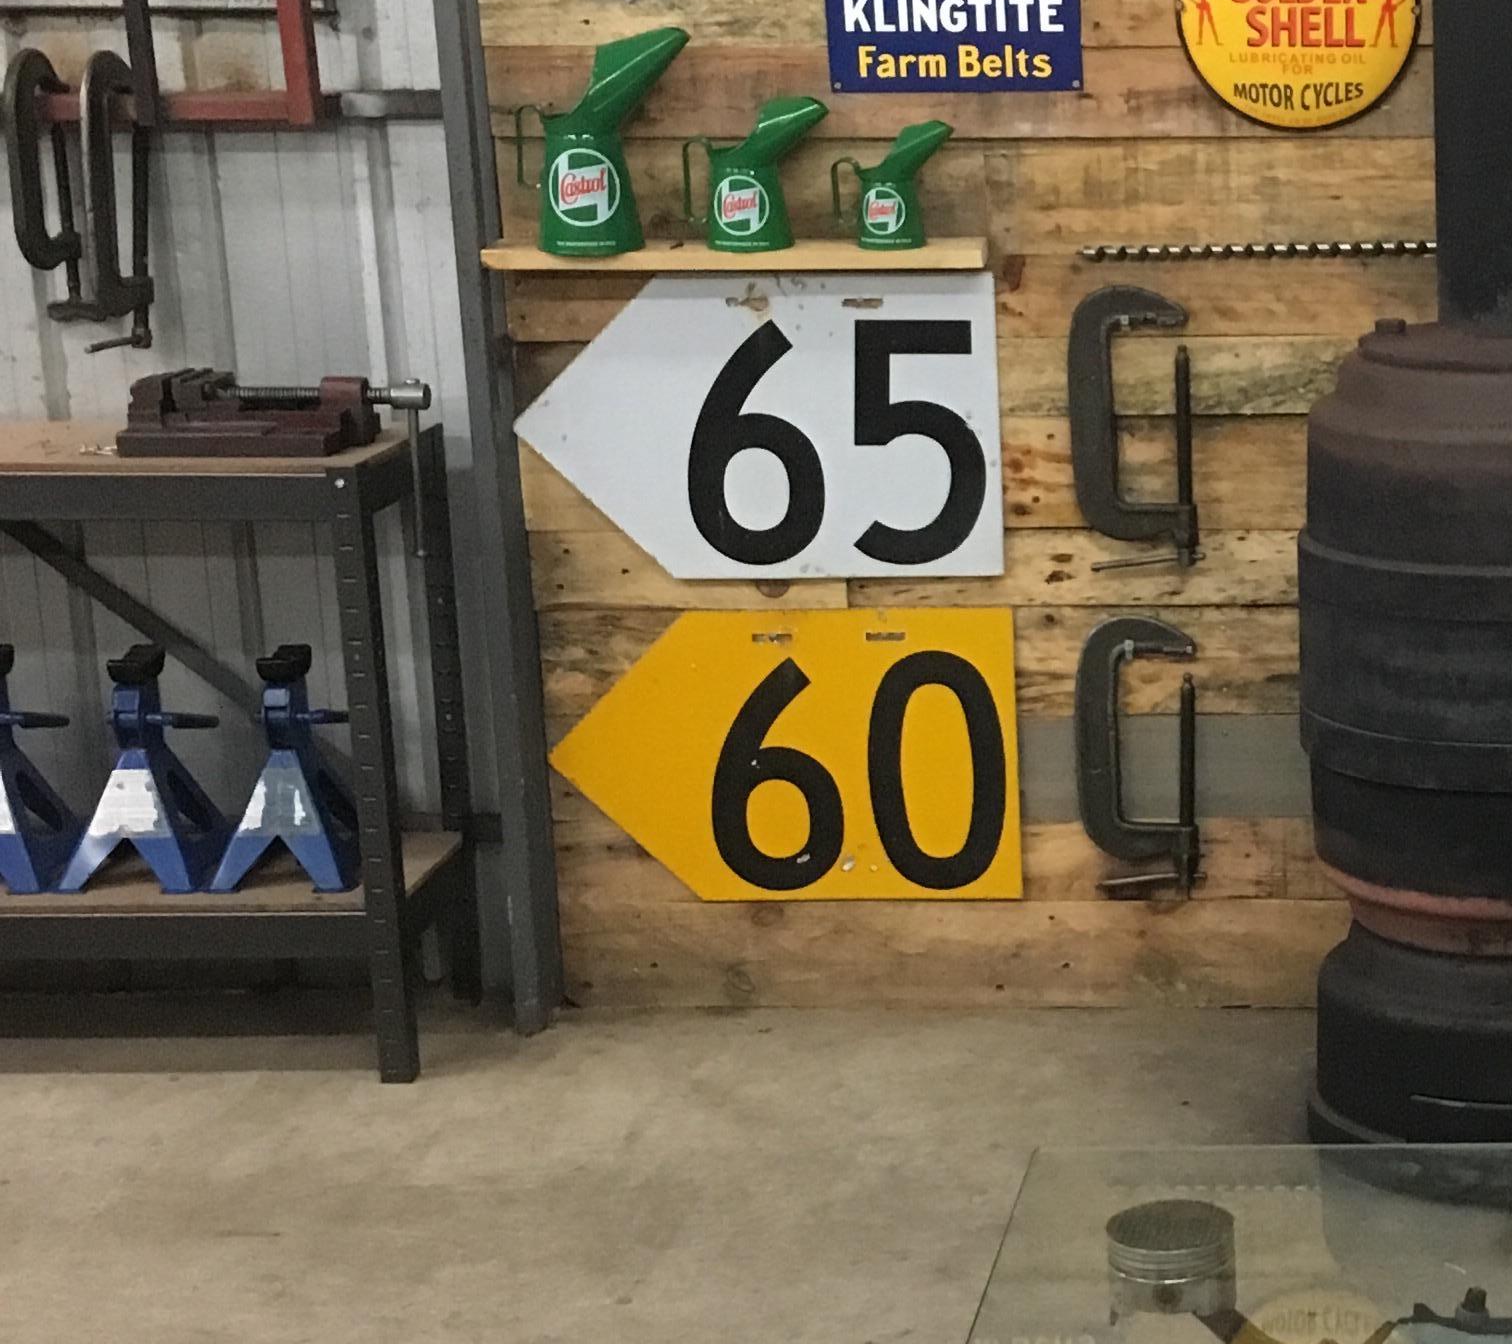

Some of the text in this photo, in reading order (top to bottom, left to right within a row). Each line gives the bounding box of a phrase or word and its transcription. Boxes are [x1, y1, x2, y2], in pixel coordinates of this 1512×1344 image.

[1246, 6, 1366, 48] SHELL
[858, 44, 1052, 79] Farm Belts
[1229, 52, 1366, 65] LUBRICATING OIL
[1282, 64, 1314, 76] FOR
[1234, 82, 1364, 111] MOTOR CYCLES
[561, 167, 606, 205] Castrol
[723, 190, 757, 219] Castrol
[688, 319, 987, 565] 65
[711, 650, 1006, 890] 60
